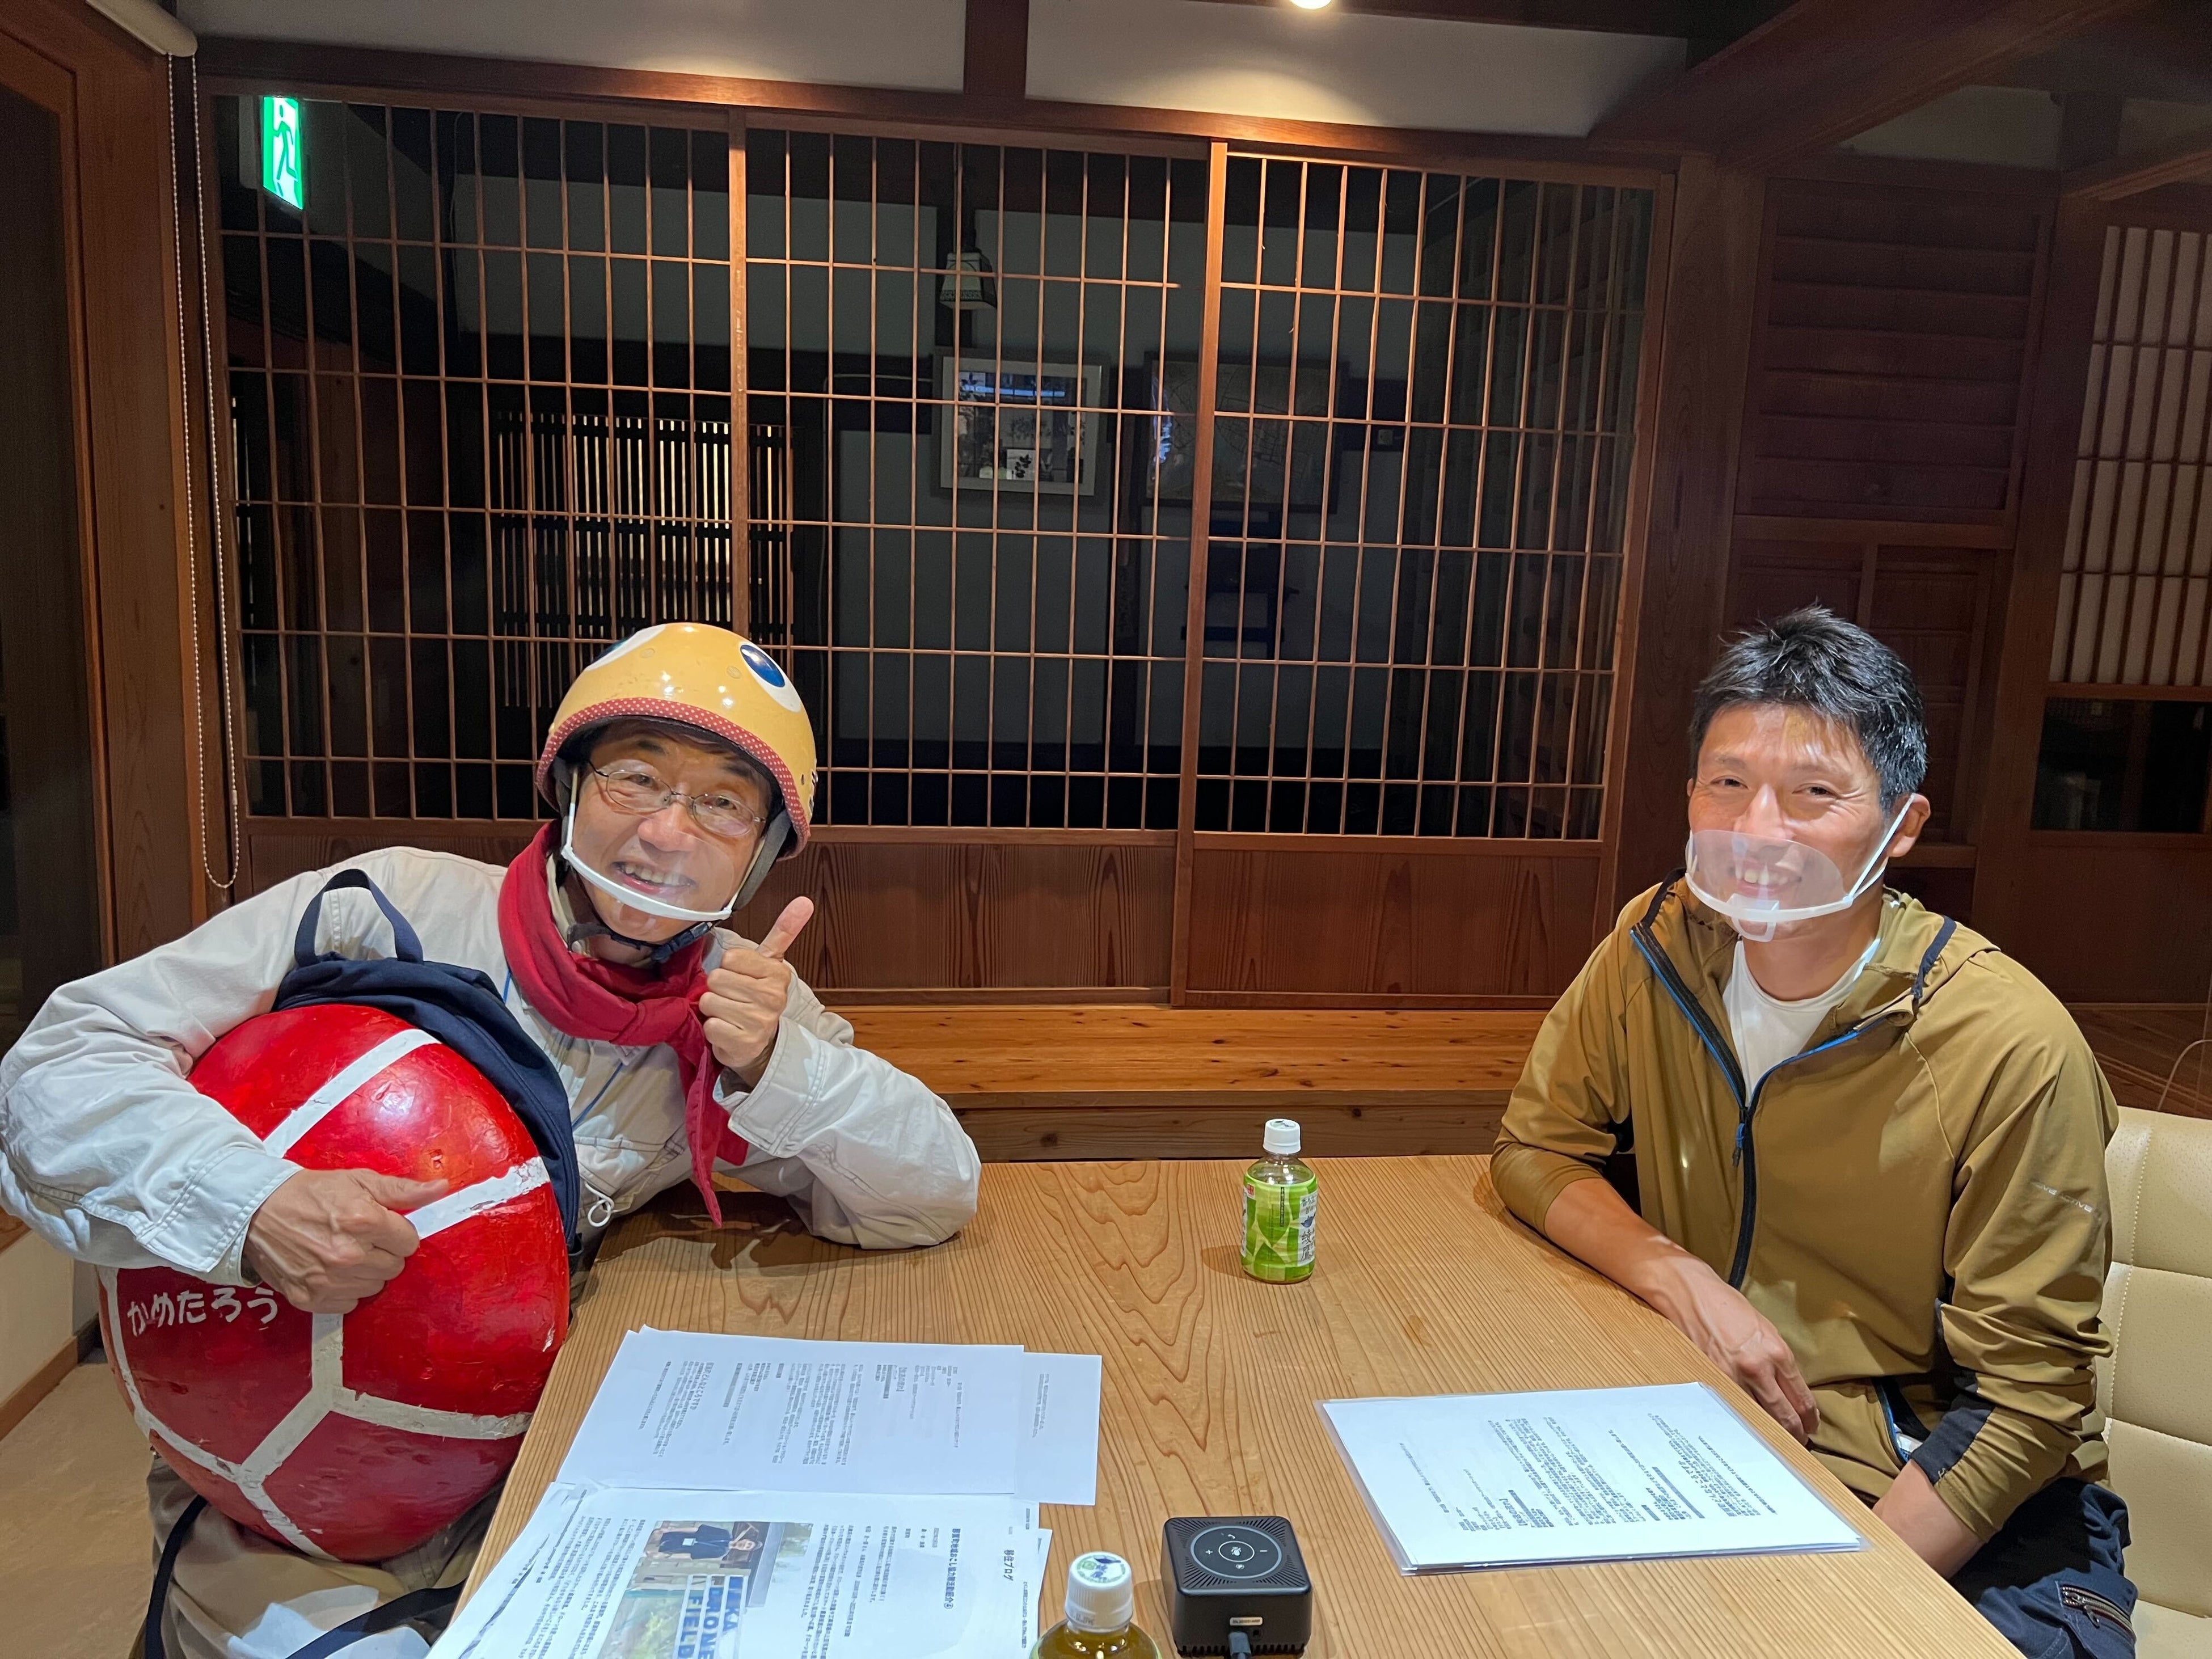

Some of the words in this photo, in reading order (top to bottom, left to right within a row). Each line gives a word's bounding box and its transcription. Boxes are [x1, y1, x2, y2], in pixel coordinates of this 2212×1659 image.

[127, 1286, 278, 1337] かめたろう
[1003, 1549, 1015, 1581] 移住ブログ
[677, 1595, 704, 1658] FIELD
